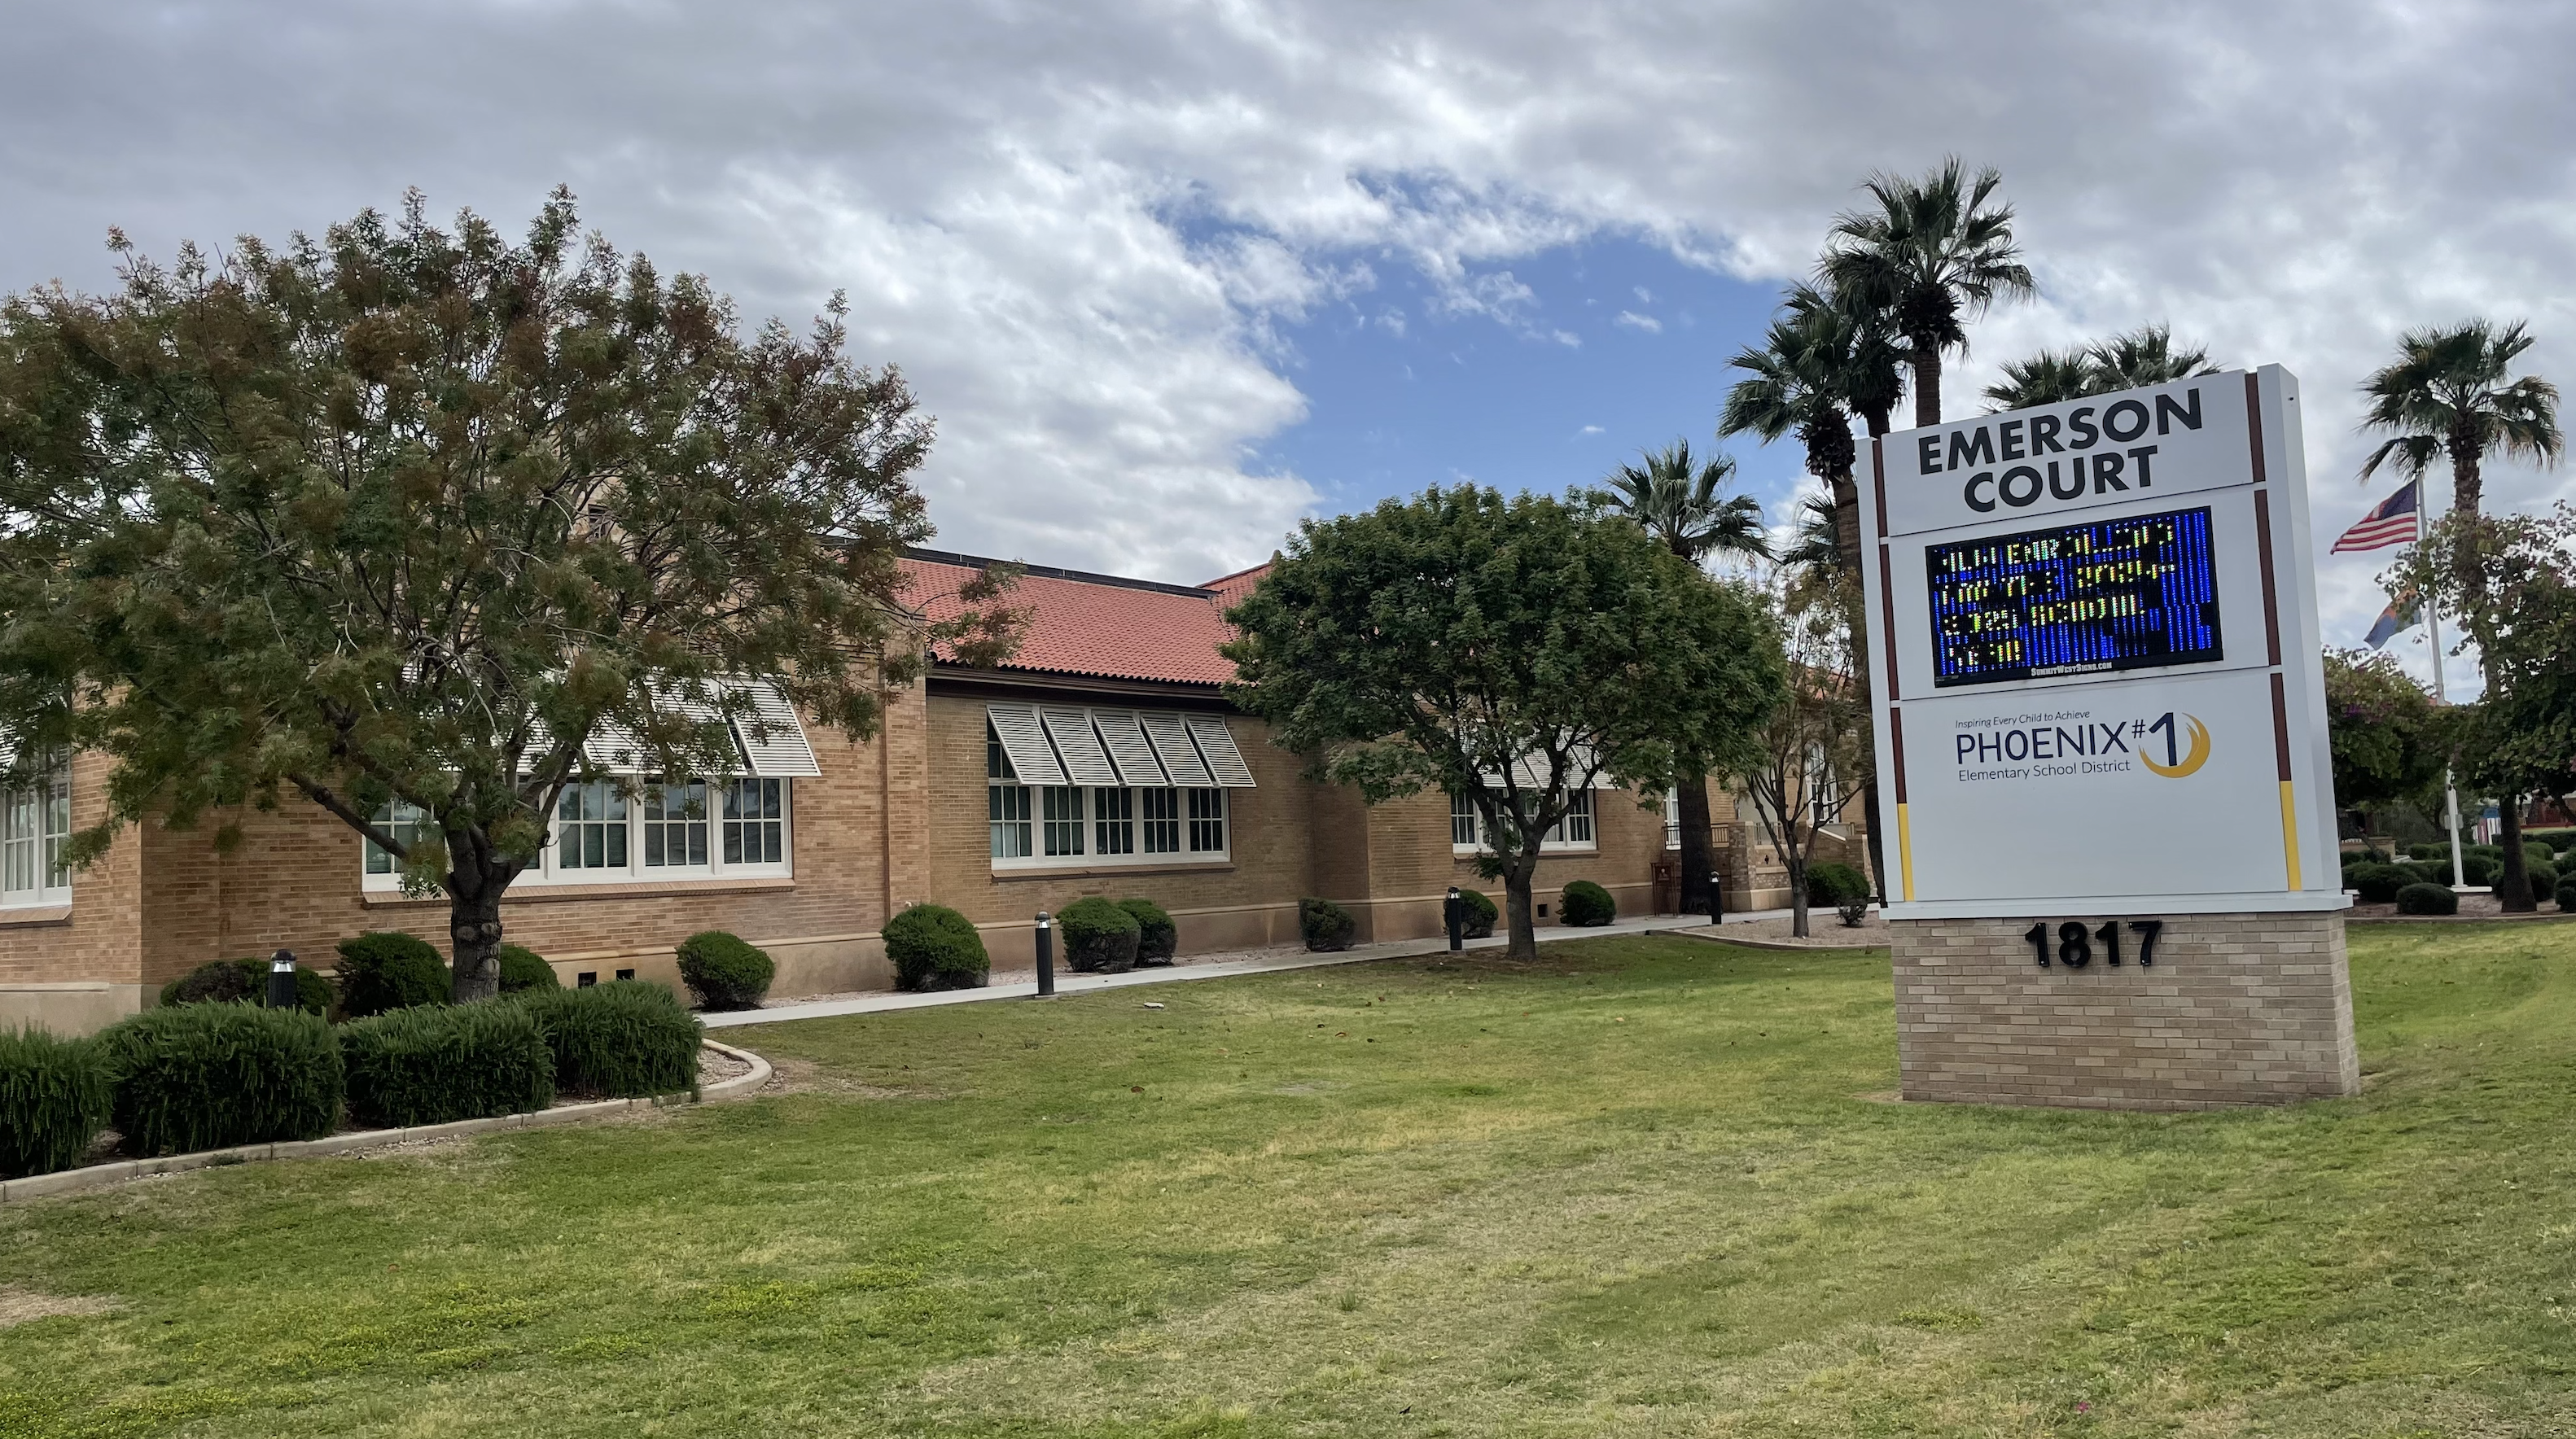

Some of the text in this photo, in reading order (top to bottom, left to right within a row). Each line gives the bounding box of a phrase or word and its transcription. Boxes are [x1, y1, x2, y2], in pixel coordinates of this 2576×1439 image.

[1918, 387, 2202, 475] EMERSON
[1964, 444, 2158, 513] COURT
[1955, 710, 2090, 729] Inspiring Every Child to Achieve
[1956, 721, 2130, 765] PHOENIX
[1959, 759, 2131, 781] Elementary School District
[2025, 920, 2162, 968] 1817
